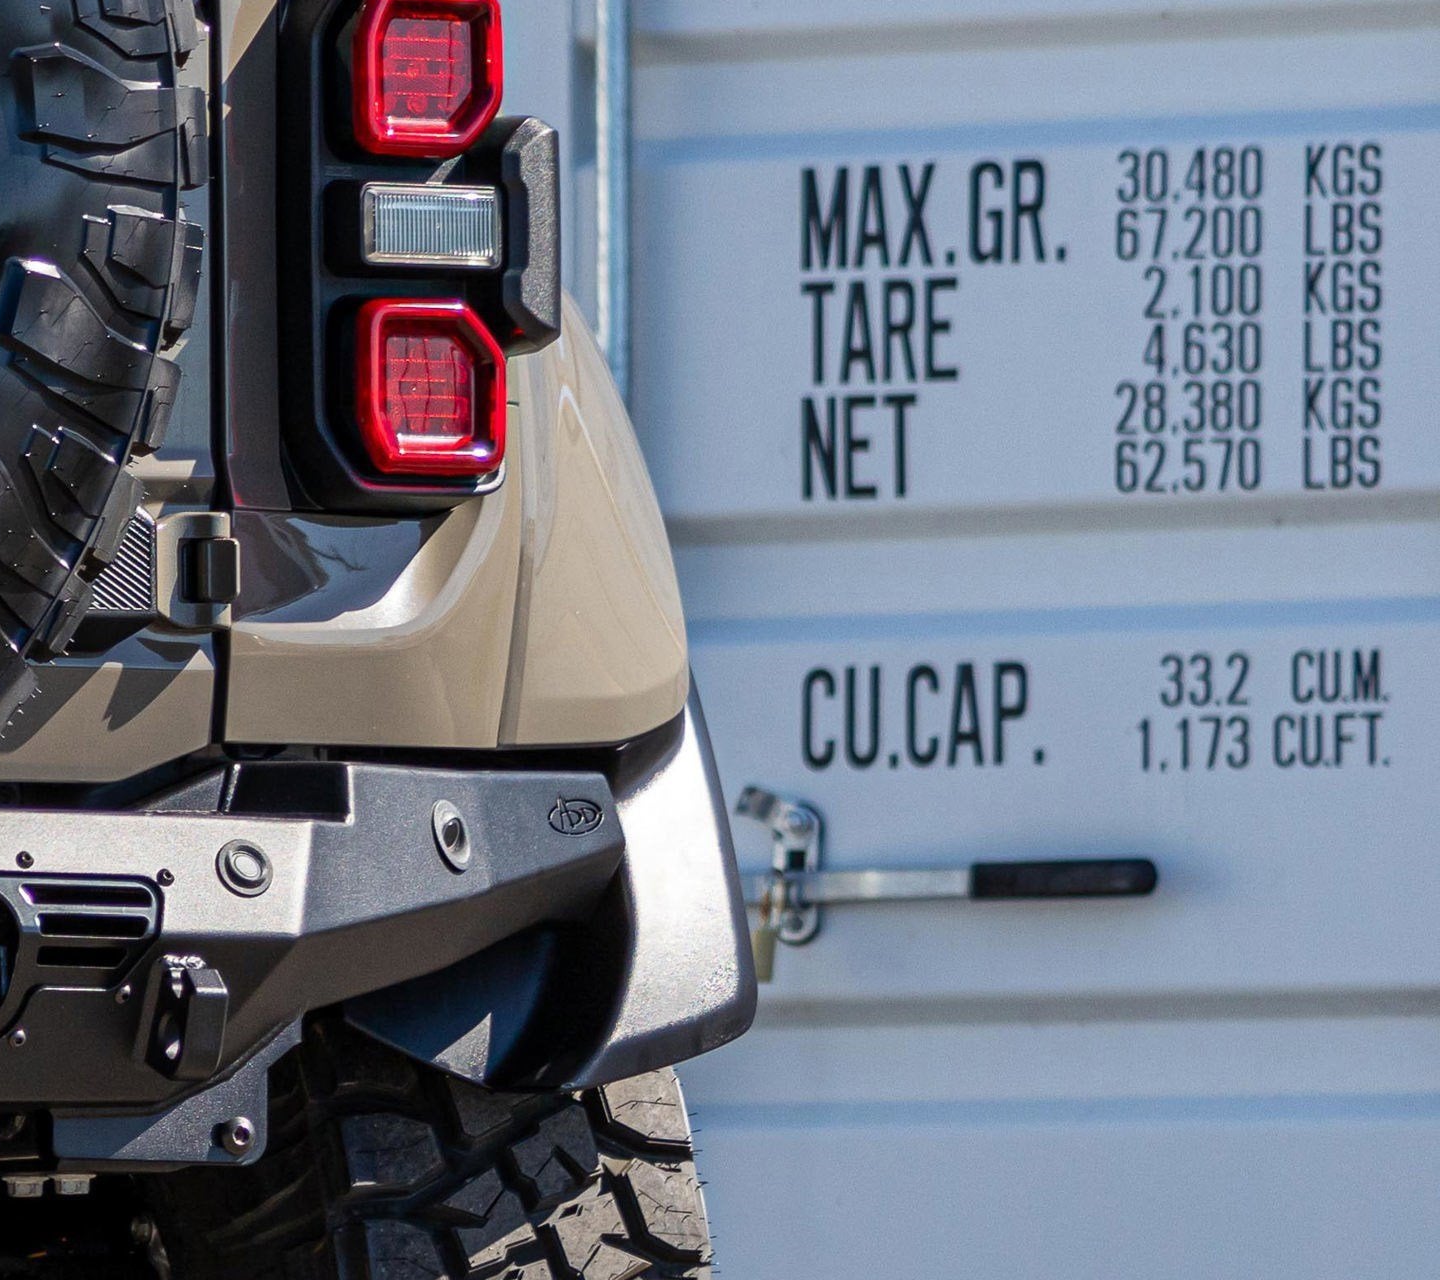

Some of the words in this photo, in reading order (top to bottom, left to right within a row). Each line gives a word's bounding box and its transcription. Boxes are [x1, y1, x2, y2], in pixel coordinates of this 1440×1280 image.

[800, 158, 1068, 271] MAX.GR.
[1116, 145, 1264, 202] 30.480
[1305, 143, 1384, 198] KGS
[1115, 205, 1263, 261] 67.200
[1303, 202, 1384, 257] LBS
[801, 277, 960, 384] TARE
[1143, 265, 1263, 319] 2.100
[1303, 261, 1384, 315] KGS
[1143, 322, 1262, 378] 4.630
[1302, 319, 1384, 373] LBS
[800, 393, 918, 501] NET
[1115, 380, 1262, 435] 28.380
[1302, 377, 1384, 431] KGS
[1115, 438, 1262, 494] 62.570
[1301, 435, 1383, 490] LBS
[800, 660, 1047, 770] CU.CAP.
[1160, 653, 1251, 708] 33.2
[1137, 717, 1252, 771] 1.173
